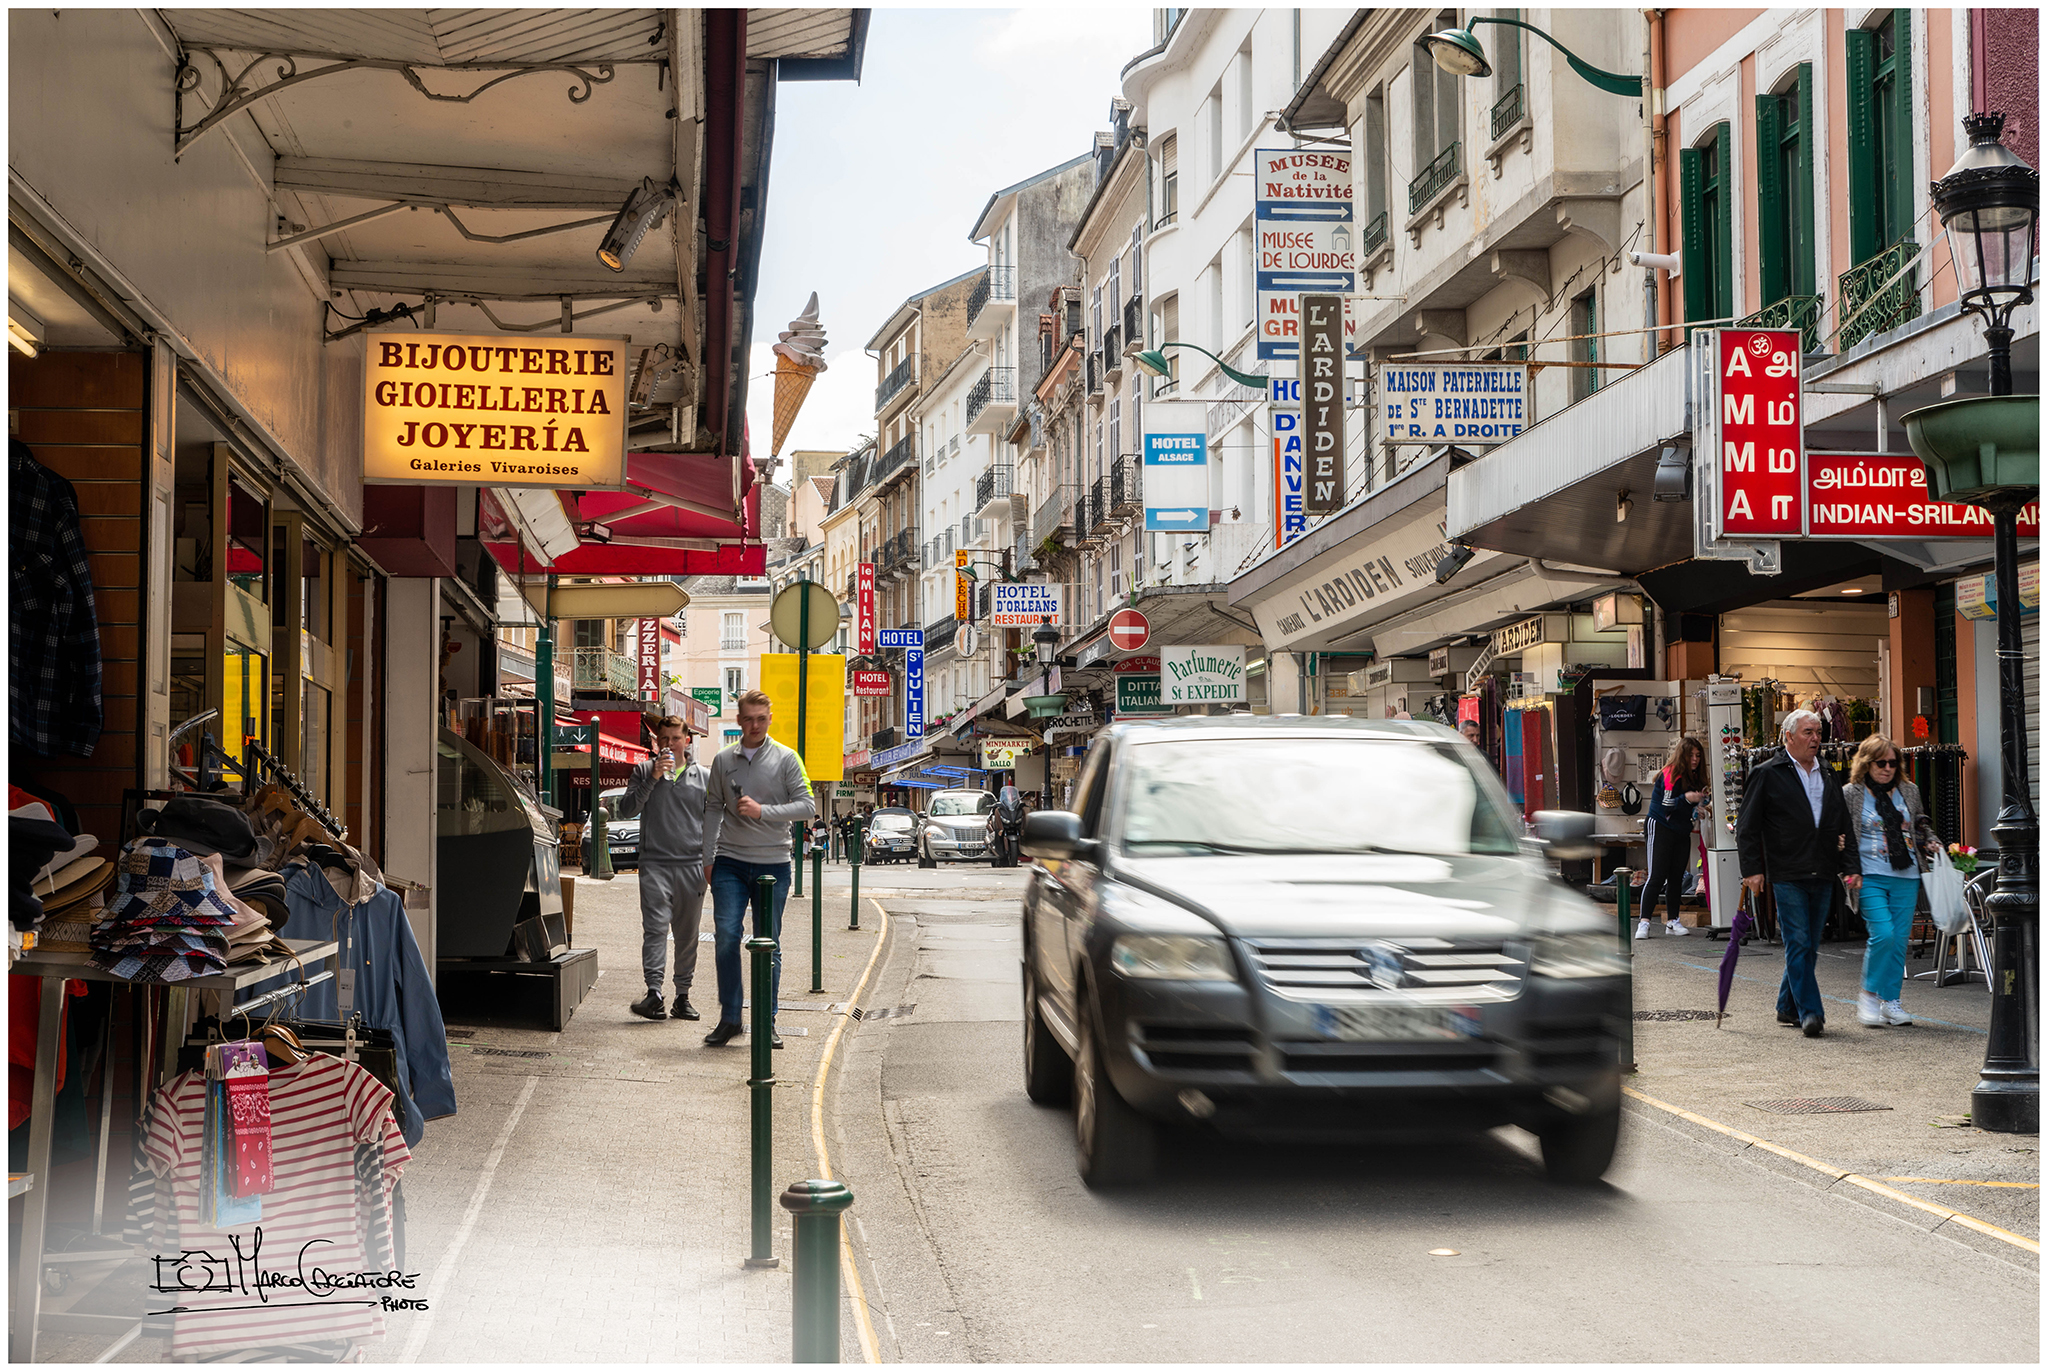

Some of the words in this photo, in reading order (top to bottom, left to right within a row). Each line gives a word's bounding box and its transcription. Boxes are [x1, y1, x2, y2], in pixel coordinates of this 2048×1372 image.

[1268, 153, 1350, 173] MUSÉE
[1292, 171, 1307, 180] de
[1314, 171, 1327, 180] la
[1266, 183, 1352, 198] Nativité
[1263, 232, 1313, 248] MUSEE
[1263, 252, 1282, 268] DE
[379, 341, 614, 376] BIJOUTERIE
[1387, 371, 1436, 392] MAISON
[1443, 371, 1521, 392] PATERNELLE
[375, 380, 610, 414] GIOIELLERIA
[1310, 305, 1335, 501] L'ARDIDEN
[1388, 405, 1402, 418] DE
[1435, 398, 1522, 419] BERNADETTE
[397, 418, 590, 452] JOYERÍA
[1409, 424, 1426, 437] R.
[1433, 424, 1446, 437] A
[1454, 424, 1522, 437] DROITE
[1724, 346, 1755, 520] AMMA
[1152, 438, 1200, 449] HOTEL
[410, 458, 481, 472] Galeries
[490, 461, 579, 475] Vivaroises
[861, 566, 872, 576] le
[996, 586, 1050, 598] HOTEL
[1276, 612, 1306, 636] CADEAUX
[1300, 555, 1403, 622] L'ARDIDEN
[861, 580, 872, 641] MILAN
[996, 600, 1058, 612] D'ORLEANS
[882, 632, 921, 645] HOTEL
[1493, 617, 1543, 656] L'ARDIDEN
[641, 618, 658, 690] ZZERIA
[1119, 662, 1132, 670] DA
[1134, 658, 1161, 667] CLAUD
[859, 674, 887, 683] HOTEL
[693, 688, 720, 699] Epicerie
[855, 686, 890, 695] Restaurant
[1171, 686, 1182, 700] St
[1187, 684, 1240, 699] EXPEDIT
[909, 669, 921, 735] JULIEN
[1121, 696, 1164, 706] ITALIAN
[573, 776, 629, 786] RESAURAN
